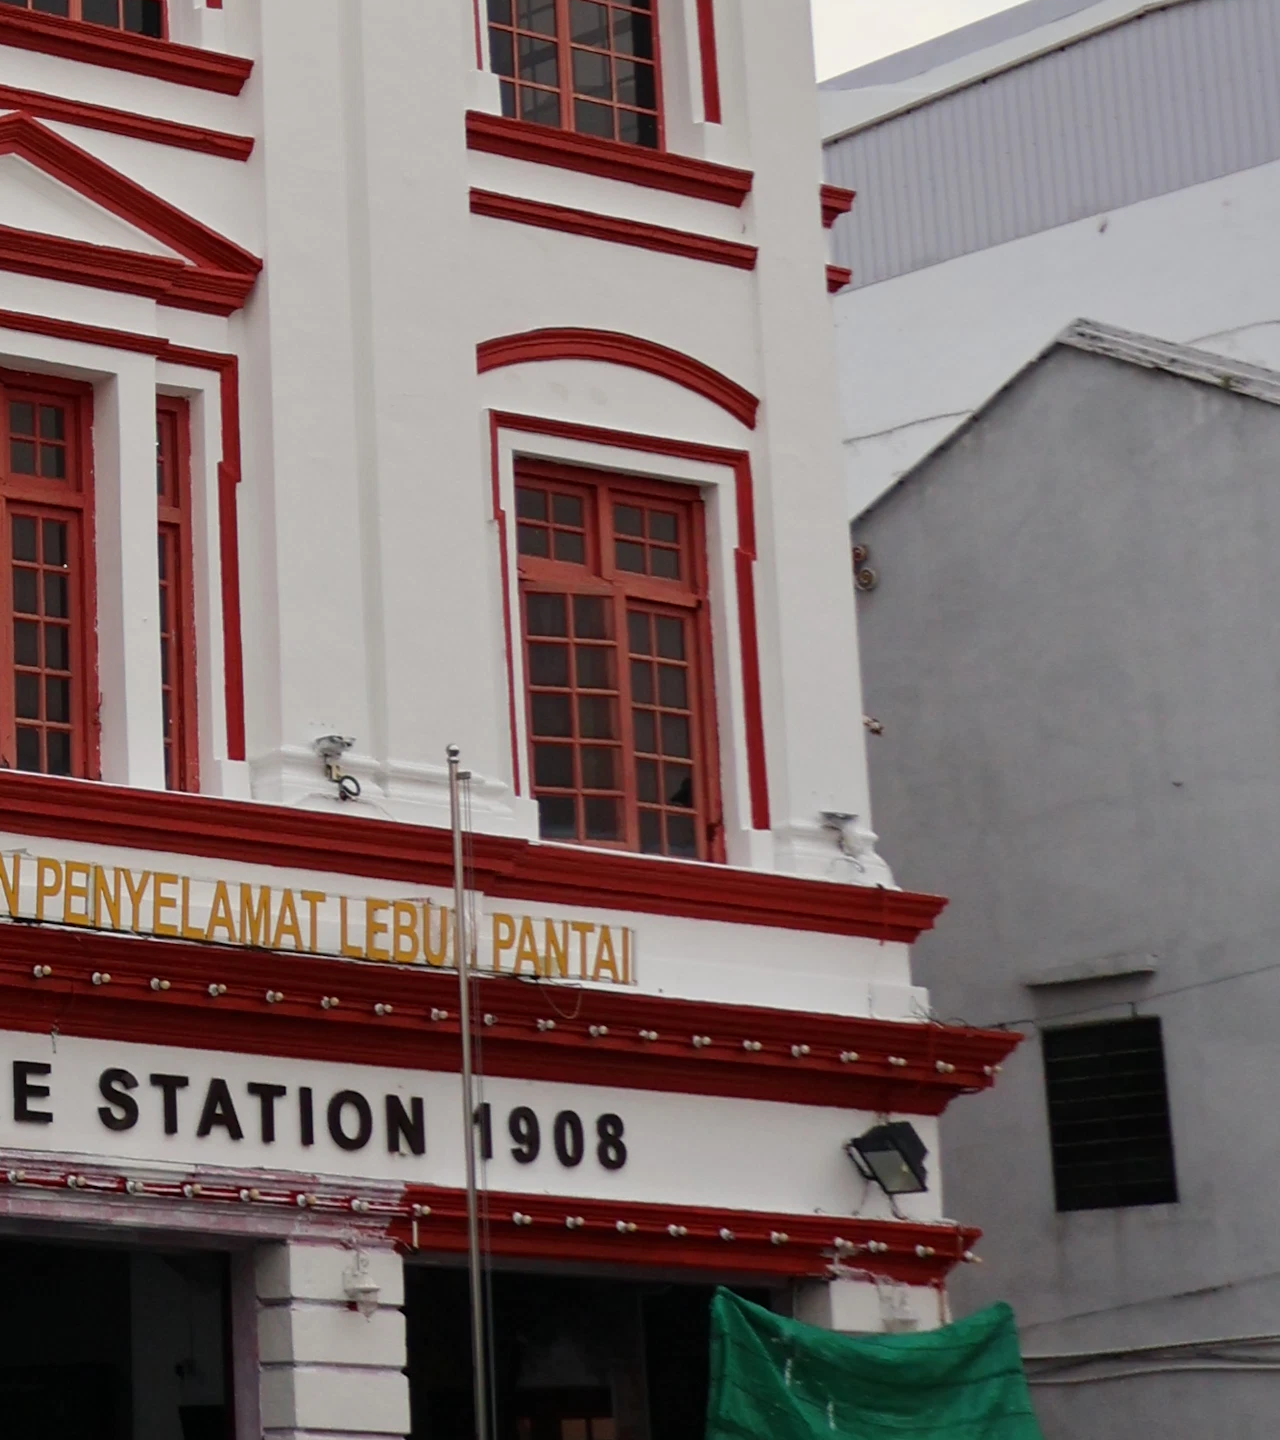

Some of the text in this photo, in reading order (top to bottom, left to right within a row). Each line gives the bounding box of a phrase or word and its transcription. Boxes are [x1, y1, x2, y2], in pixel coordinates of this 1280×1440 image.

[36, 856, 326, 952] PENYELAMAT
[493, 913, 630, 984] PANTAI
[98, 1067, 426, 1155] STATION
[472, 1101, 627, 1170] 1908
